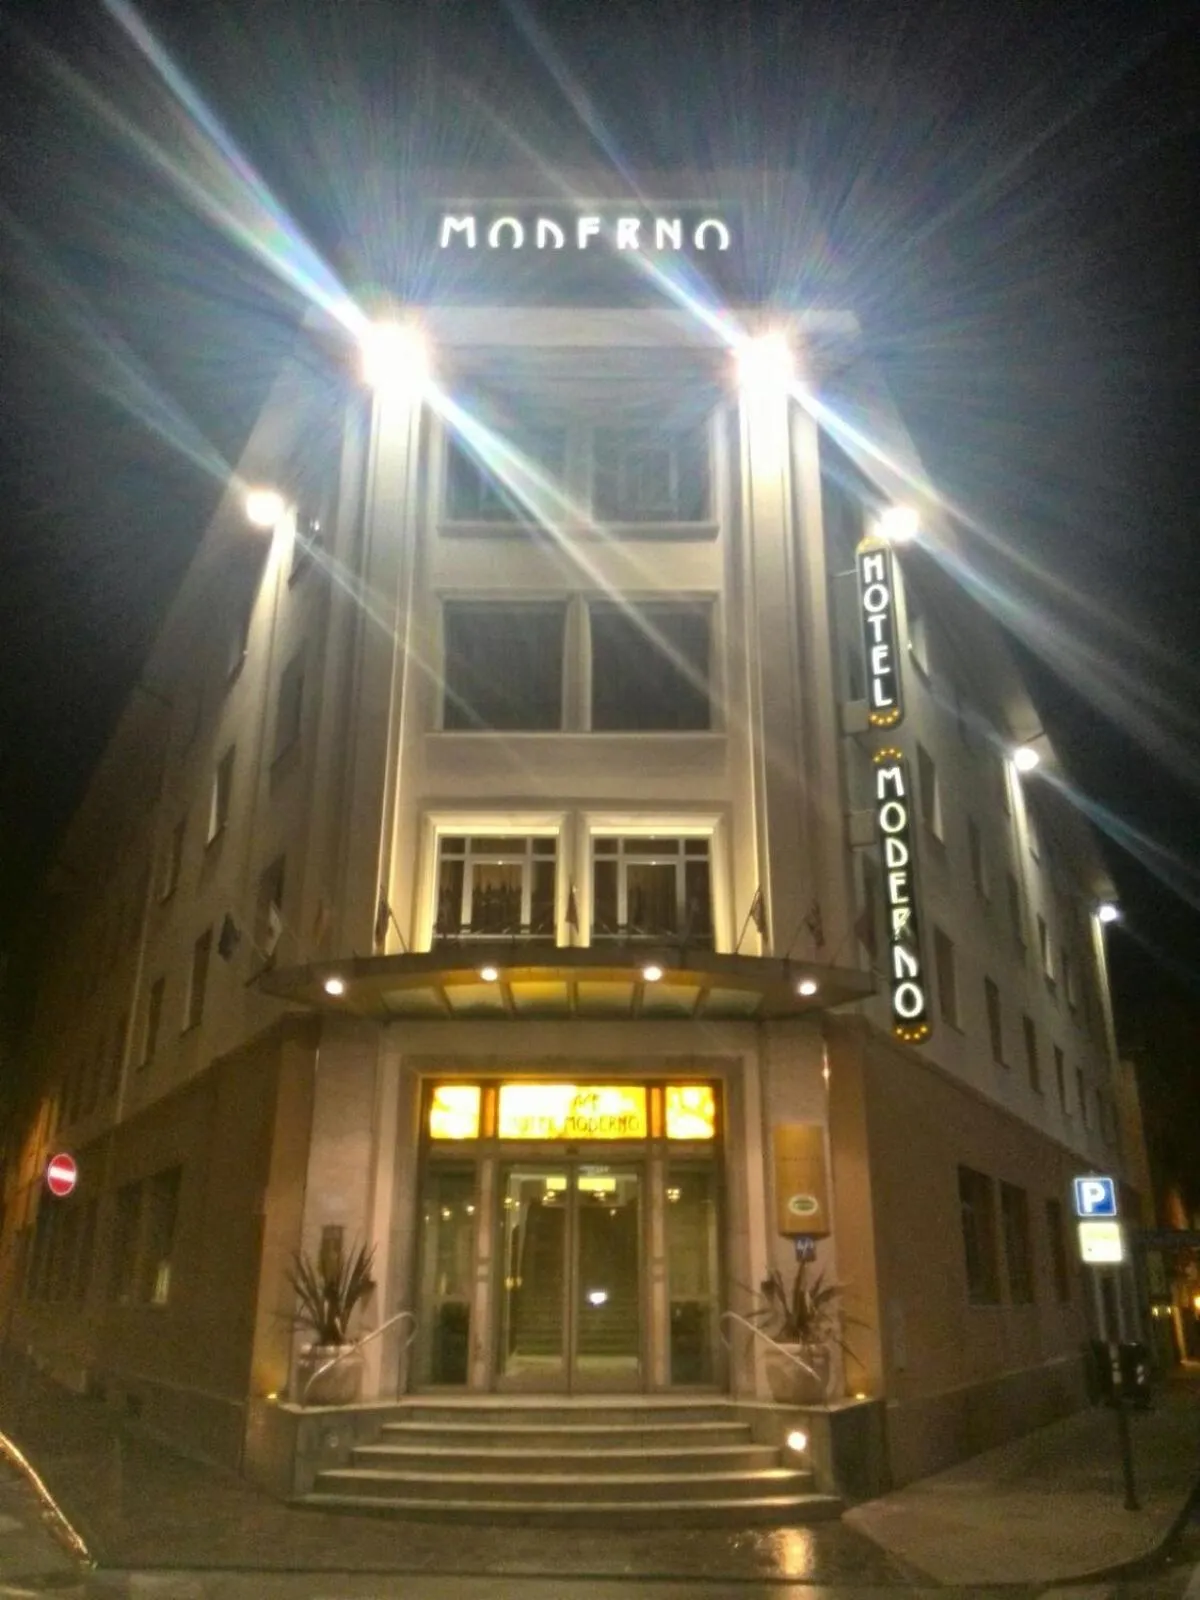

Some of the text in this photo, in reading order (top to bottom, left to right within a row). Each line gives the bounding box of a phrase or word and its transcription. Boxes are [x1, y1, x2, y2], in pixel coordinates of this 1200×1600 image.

[863, 555, 893, 707] HOTEL
[877, 766, 924, 1018] MODERNO
[565, 1115, 641, 1134] MODERNO
[1081, 1182, 1106, 1214] P
